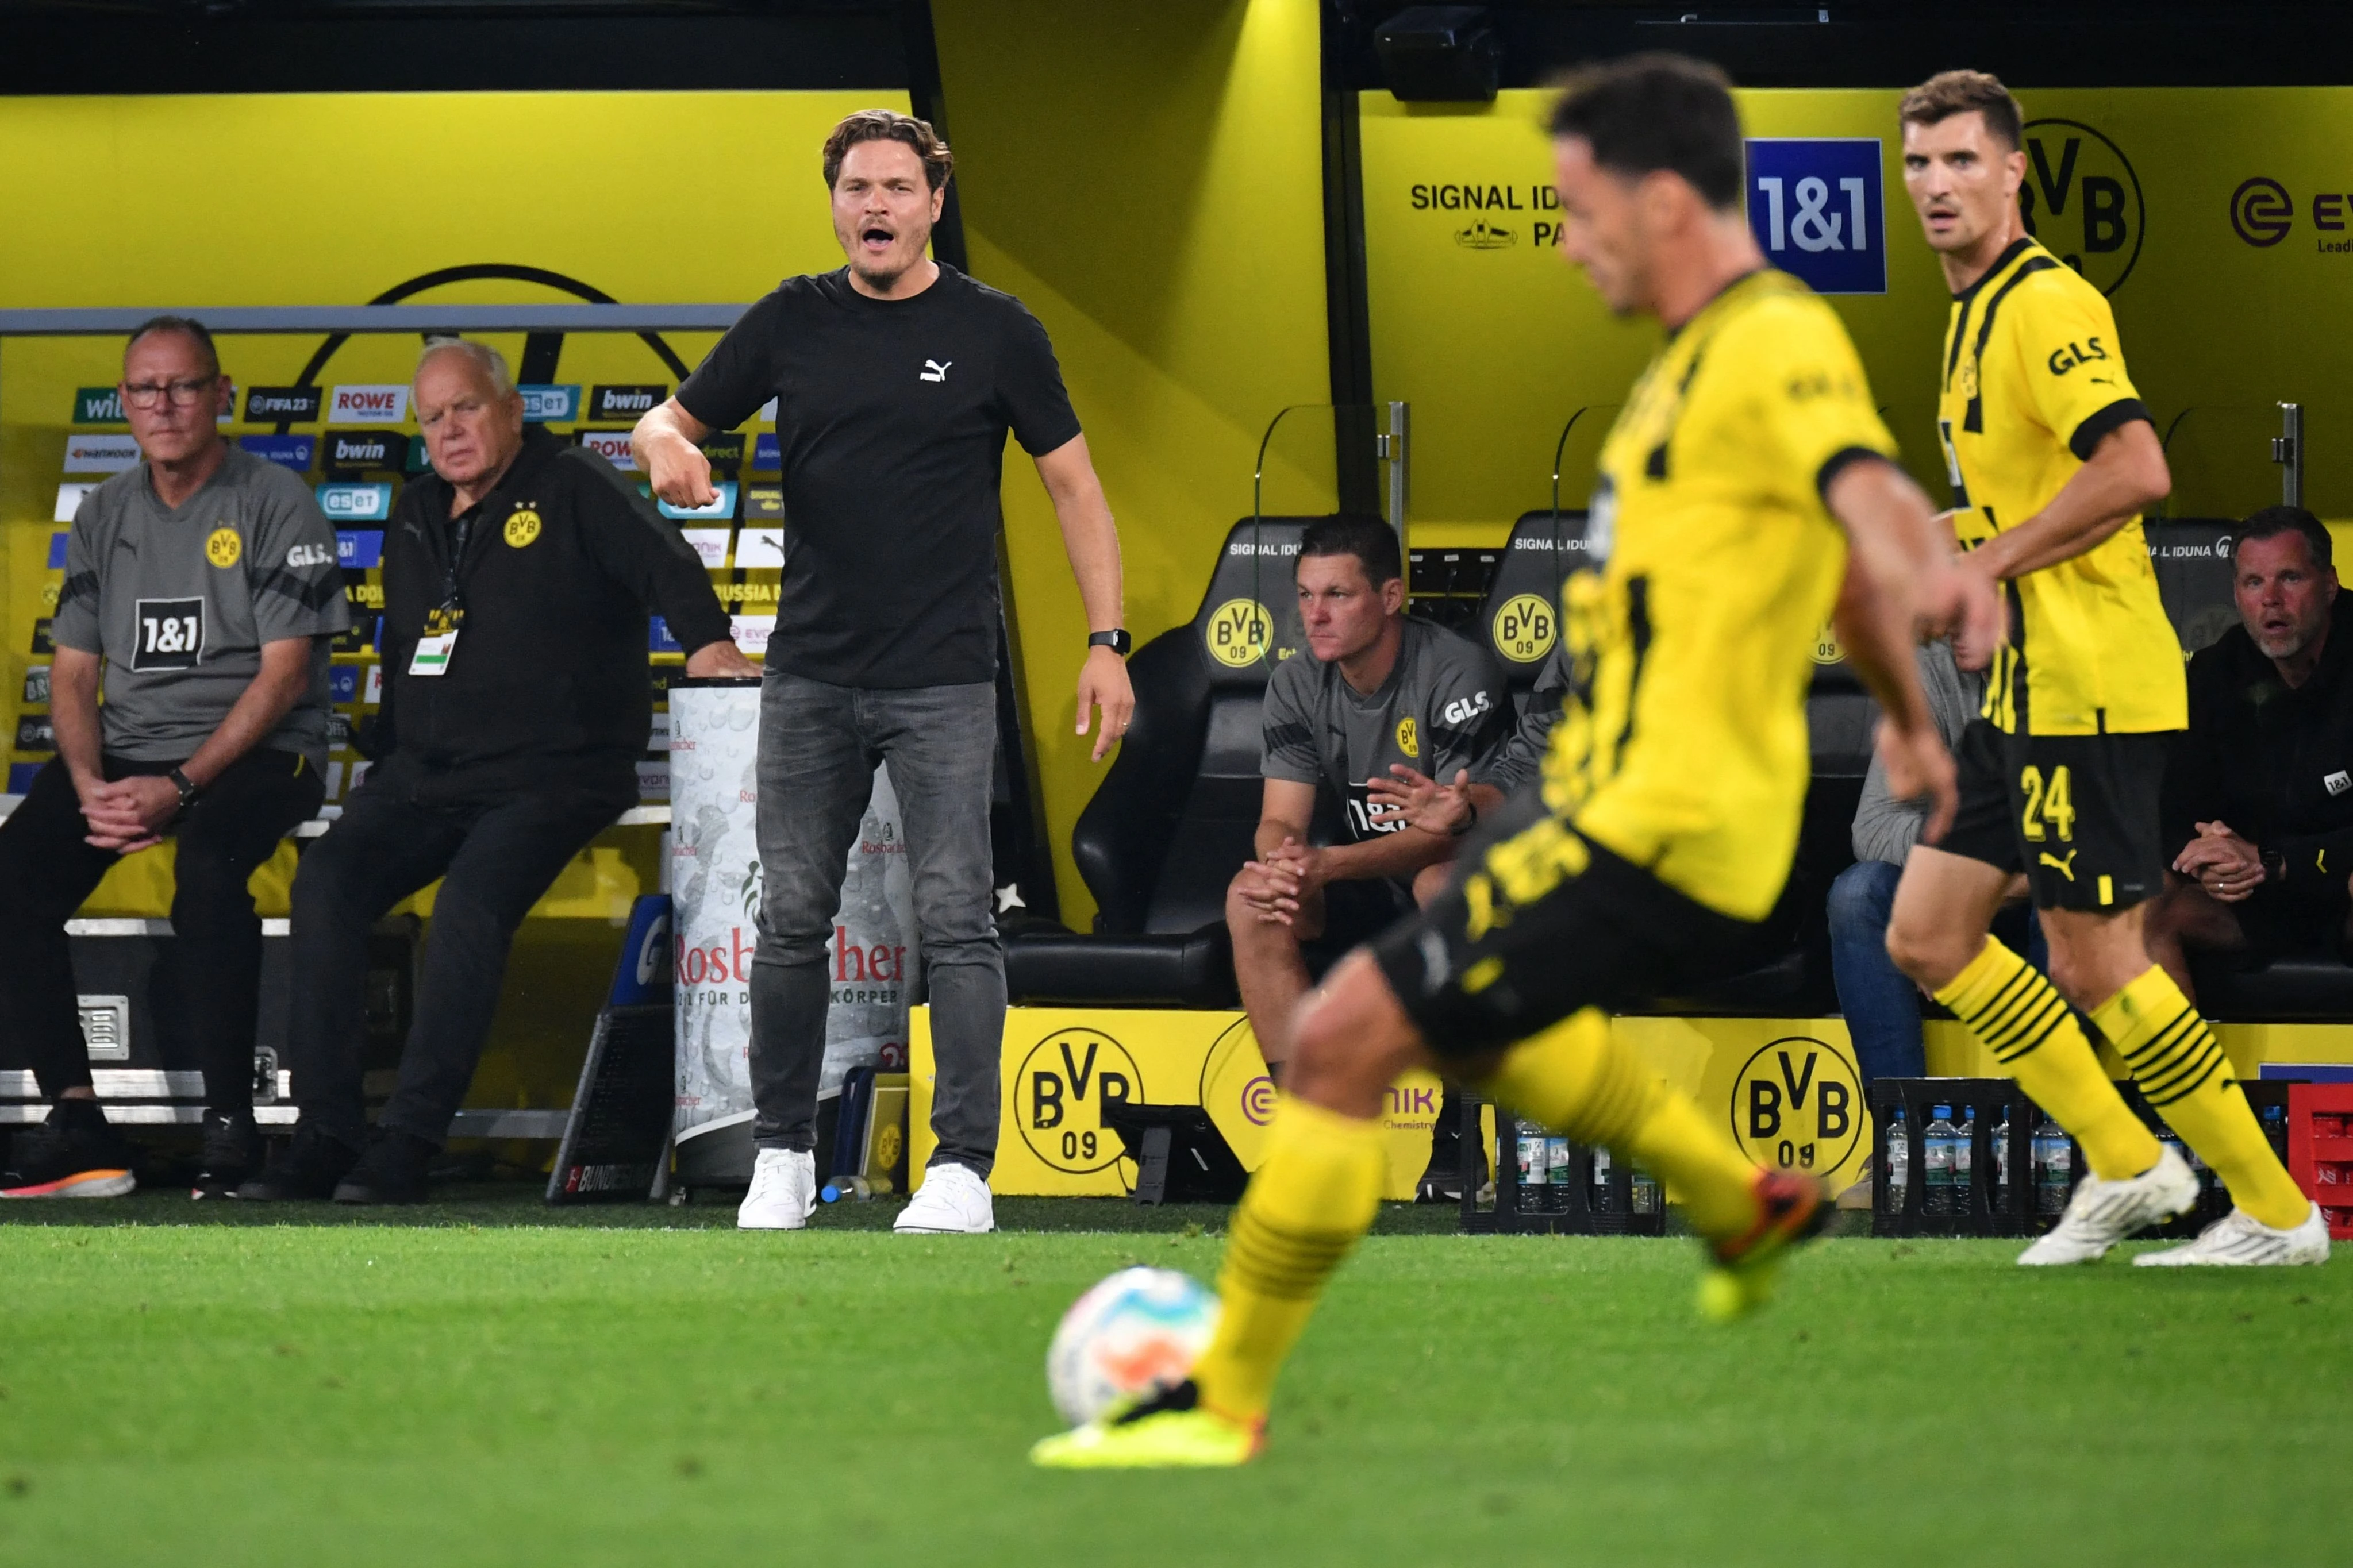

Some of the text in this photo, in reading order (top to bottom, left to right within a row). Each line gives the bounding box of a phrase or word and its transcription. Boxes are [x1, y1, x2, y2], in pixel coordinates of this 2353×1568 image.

[1411, 184, 1523, 210] SIGNAL
[1759, 177, 1867, 252] 1&1
[338, 393, 395, 409] ROWE
[602, 389, 652, 409] bwin
[336, 438, 385, 459] bwin
[510, 515, 536, 535] BVB
[1515, 538, 1563, 550] SIGNAL
[2173, 546, 2212, 557] IDUNA
[1218, 608, 1265, 645] BVB
[1504, 603, 1549, 641] BVB
[144, 617, 197, 653] 1&1
[1230, 646, 1247, 659] 09
[1516, 642, 1533, 654] 09
[1818, 644, 1835, 656] 09
[2328, 777, 2348, 791] 1&1
[2021, 765, 2074, 842] 24
[699, 990, 728, 1005] FÜR
[831, 987, 897, 1004] KÖRPER
[1749, 1051, 1850, 1138] BVB
[1383, 1119, 1435, 1132] Chemistry
[1062, 1131, 1097, 1159] 09
[1778, 1140, 1814, 1169] 09
